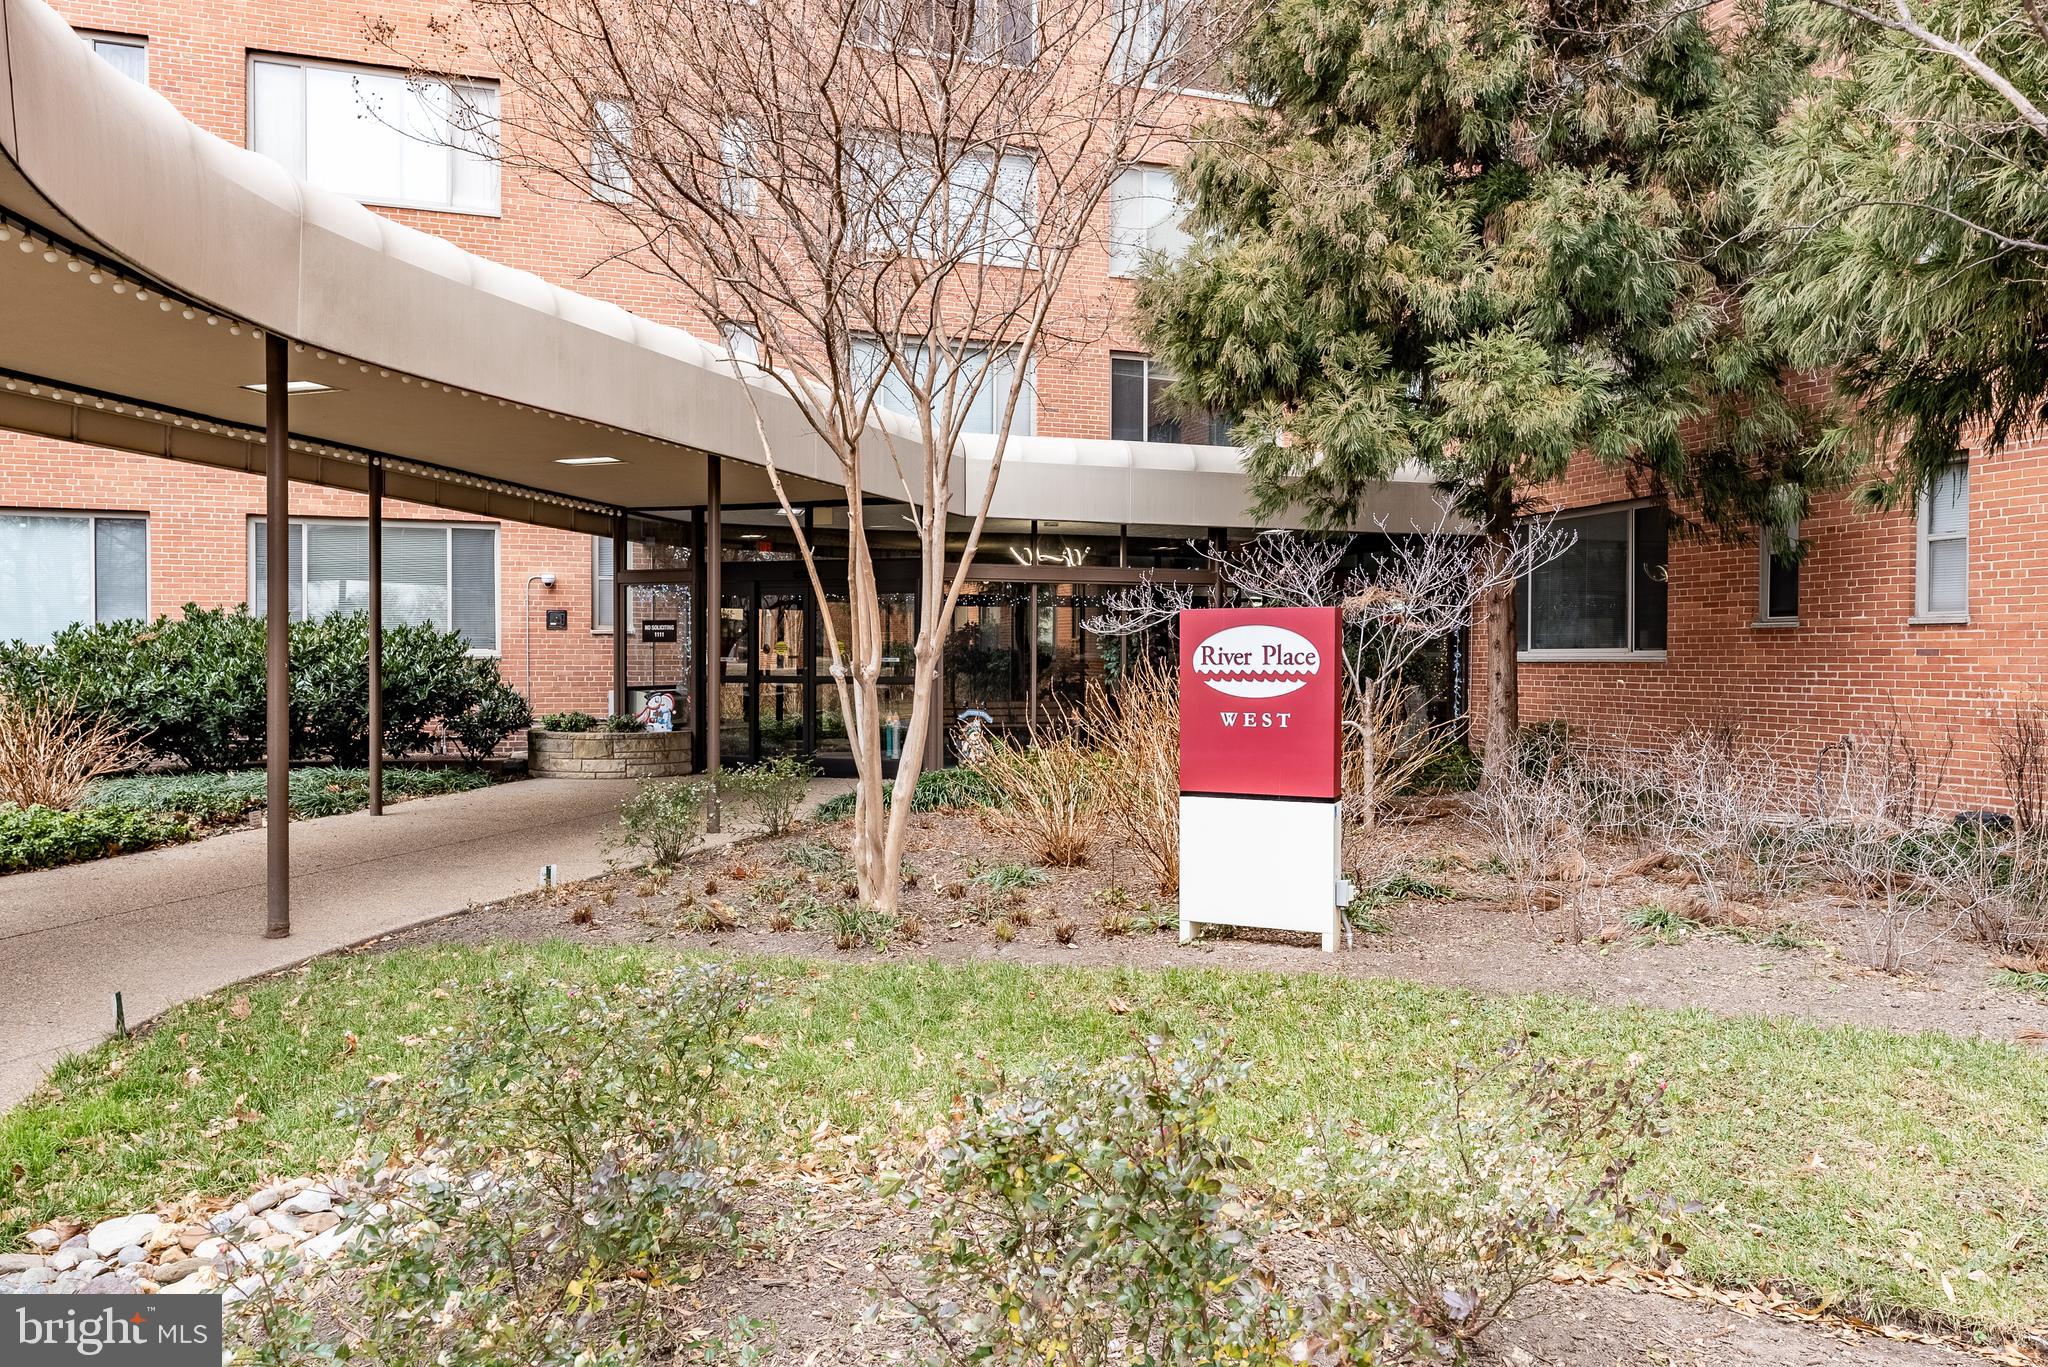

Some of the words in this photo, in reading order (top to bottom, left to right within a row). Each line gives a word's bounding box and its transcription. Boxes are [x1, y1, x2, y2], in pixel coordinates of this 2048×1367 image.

[1200, 645, 1252, 666] River
[1262, 643, 1316, 666] Place
[1220, 712, 1291, 728] WEST
